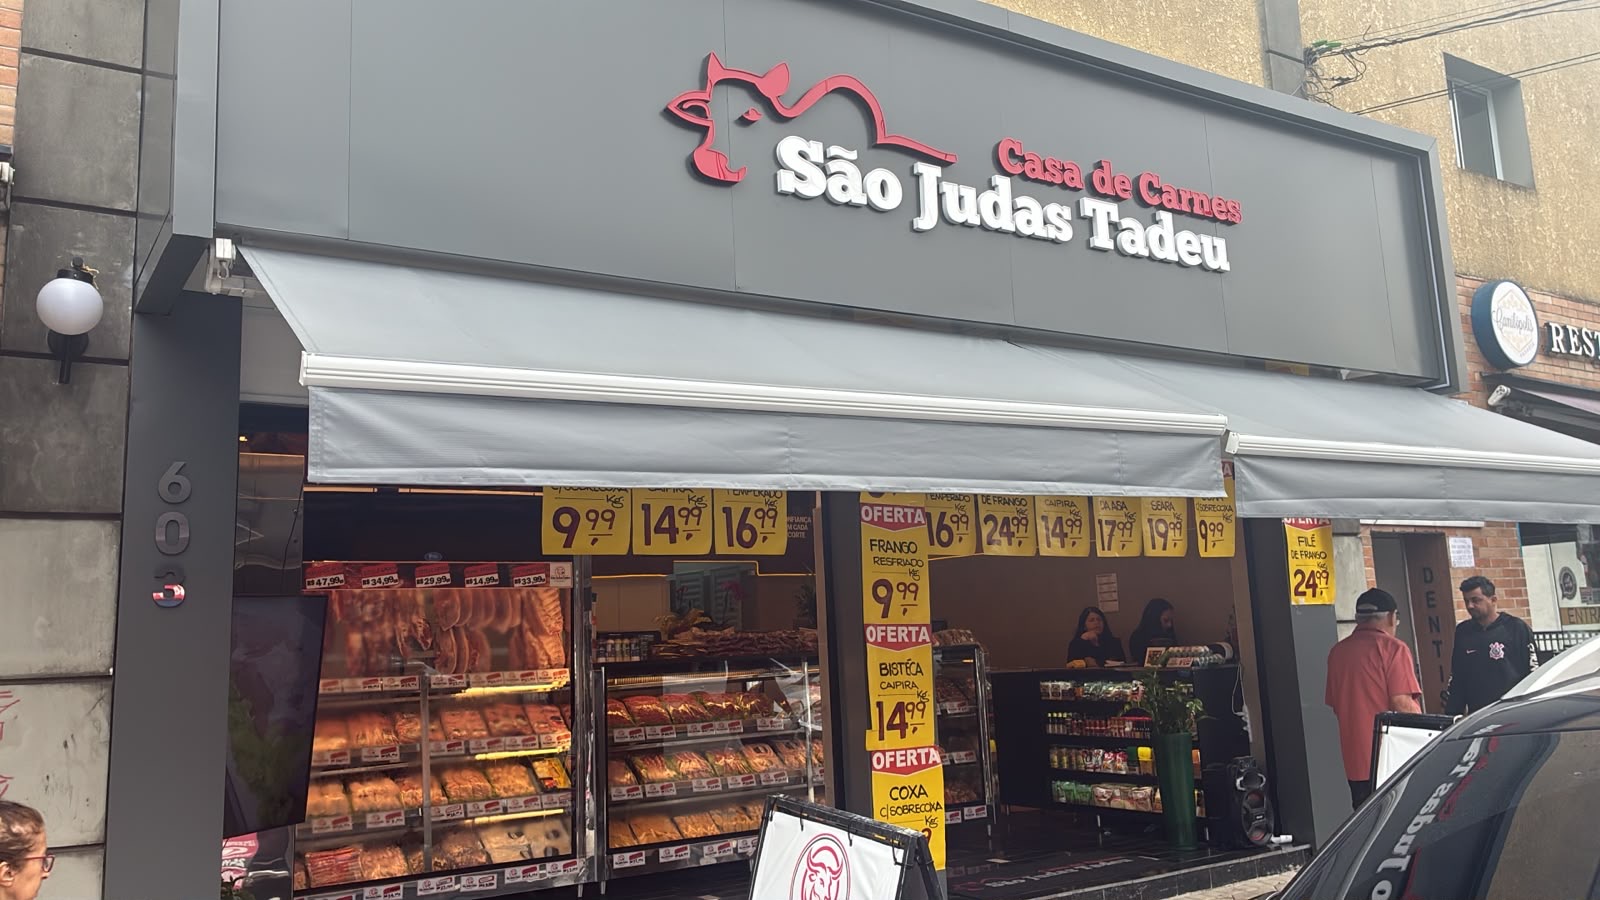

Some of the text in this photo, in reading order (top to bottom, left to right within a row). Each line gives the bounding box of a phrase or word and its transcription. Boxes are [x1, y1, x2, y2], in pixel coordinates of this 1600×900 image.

[997, 137, 1243, 225] Casa de Carnes
[775, 134, 1232, 273] São Judas Tadeu
[992, 496, 1028, 506] FRANGO
[1044, 499, 1079, 509] CAIPIRA
[1111, 501, 1128, 511] ASA
[1150, 500, 1176, 511] SEARA
[861, 505, 925, 524] OFERTA
[869, 539, 918, 554] FRANGO
[1297, 534, 1316, 547] FILÉ
[873, 556, 924, 567] RESFRIADO
[1290, 550, 1327, 560] DE FRANGO
[1568, 607, 1600, 624] ENTR
[866, 625, 931, 643] OFERTA
[879, 658, 924, 676] BISTÉCA
[880, 681, 919, 690] CAIPIRA
[872, 747, 941, 770] OFERTA
[889, 784, 928, 800] COXA
